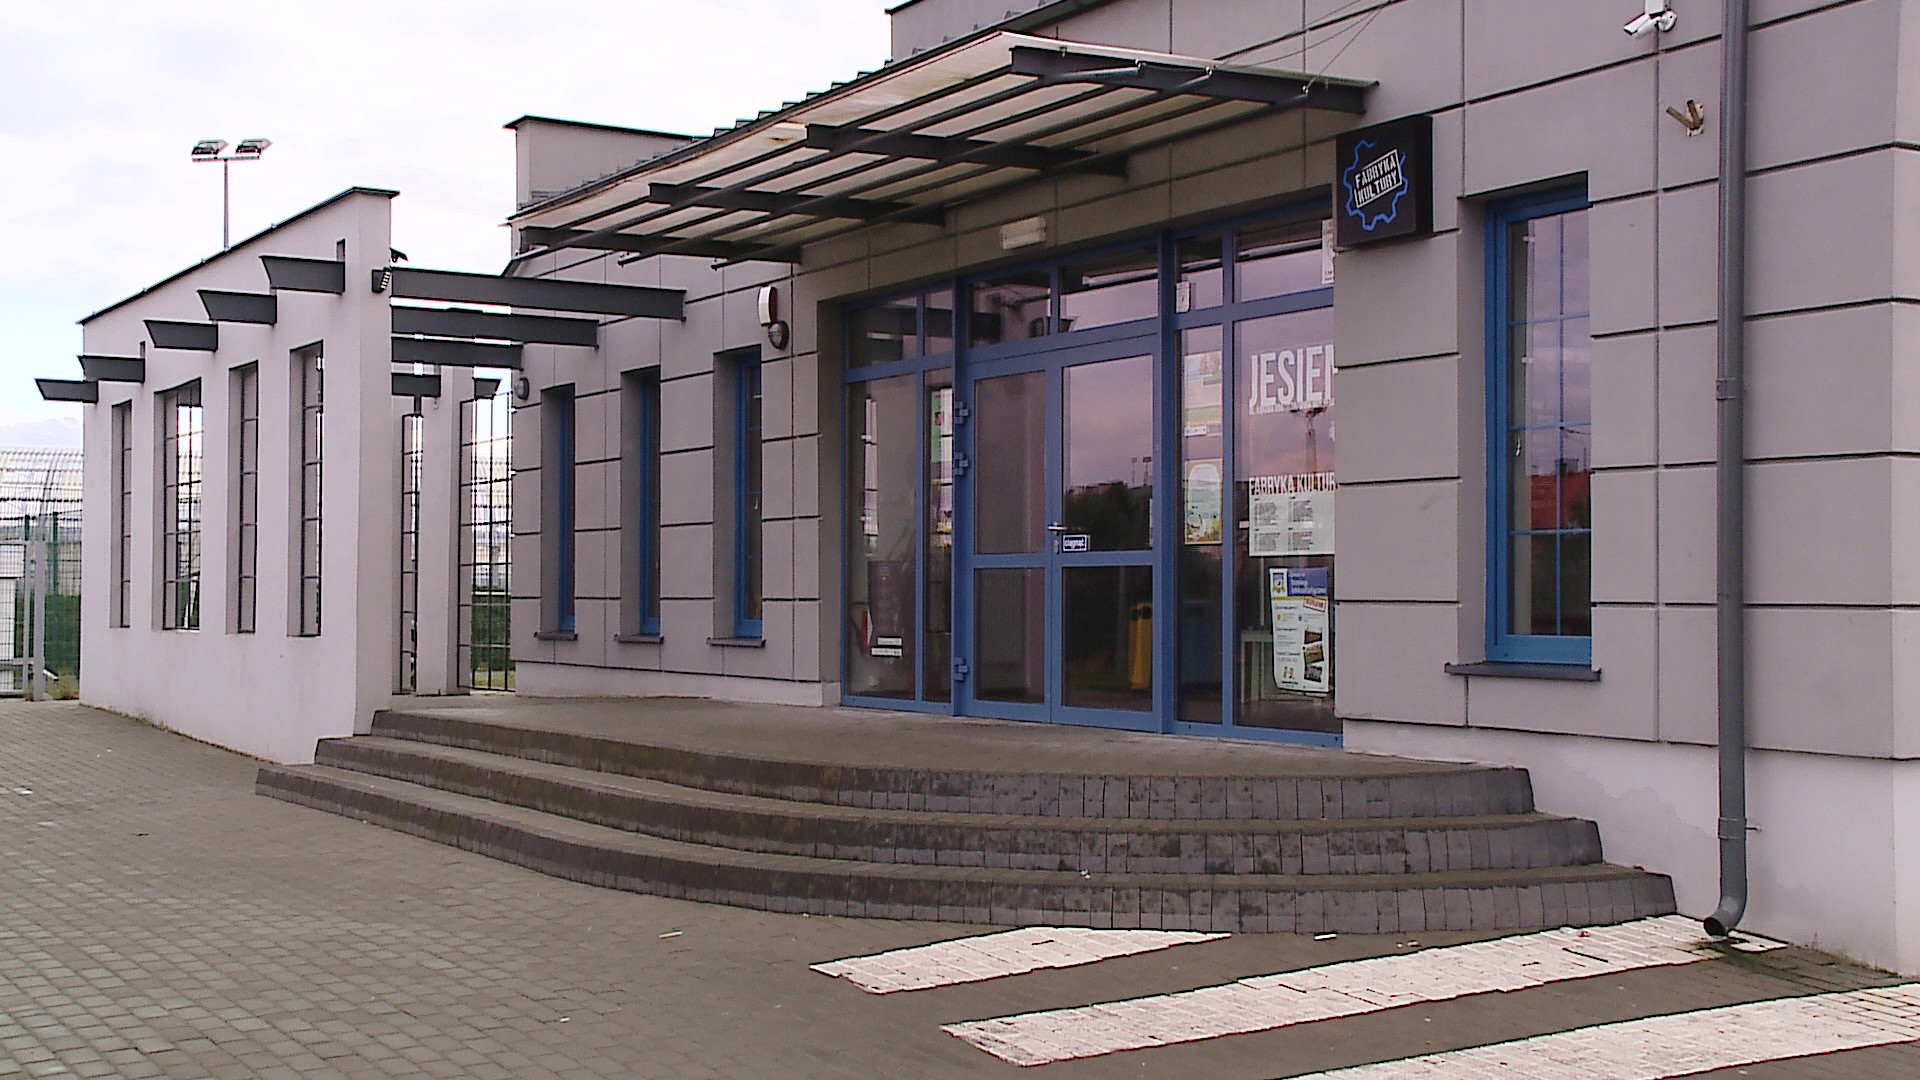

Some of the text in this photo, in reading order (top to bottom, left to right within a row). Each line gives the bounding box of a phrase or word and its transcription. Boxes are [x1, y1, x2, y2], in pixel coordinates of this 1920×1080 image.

[1355, 155, 1396, 188] FABRYKA
[1357, 170, 1397, 204] KULTURY
[1249, 474, 1296, 496] FABRYKA
